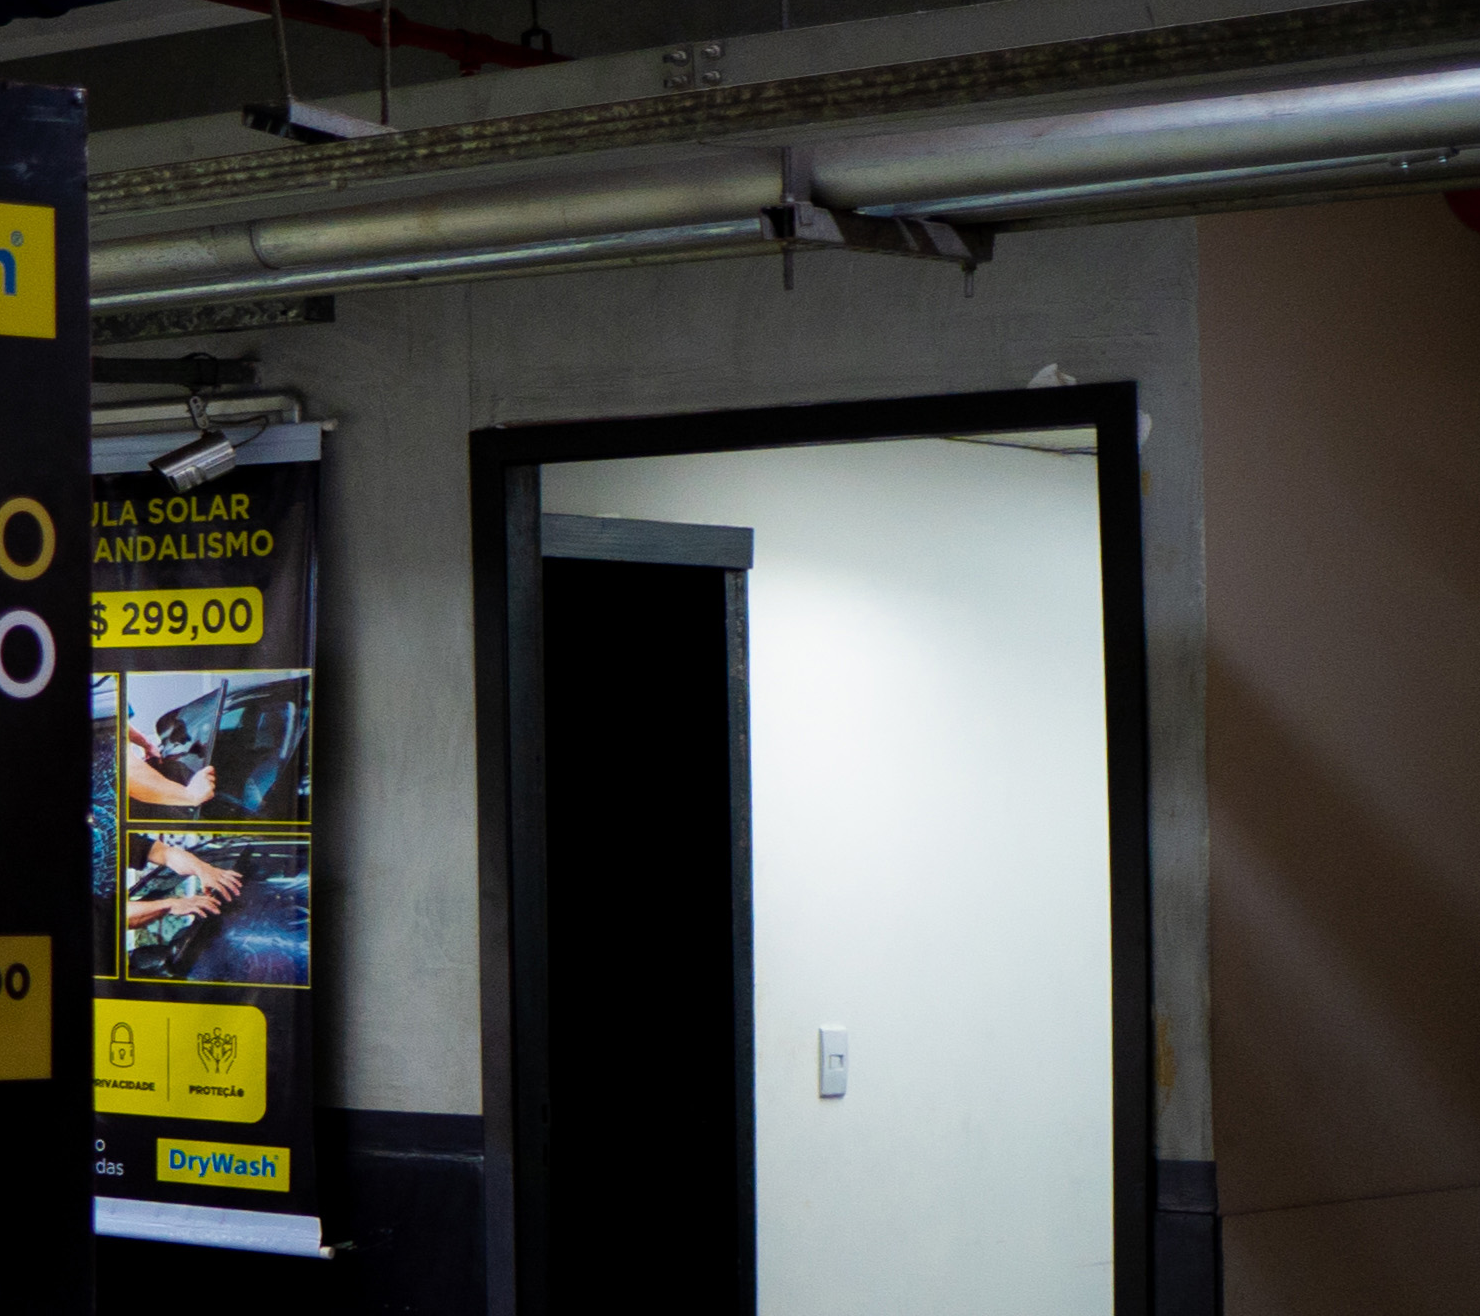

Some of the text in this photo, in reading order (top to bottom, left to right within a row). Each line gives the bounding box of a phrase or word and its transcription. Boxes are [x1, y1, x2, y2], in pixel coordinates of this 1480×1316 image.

[147, 492, 251, 525] SOLAR
[92, 528, 275, 564] ANDALISMO
[121, 597, 254, 641] 299,00
[94, 1158, 125, 1177] das
[168, 1148, 277, 1179] DryWash
